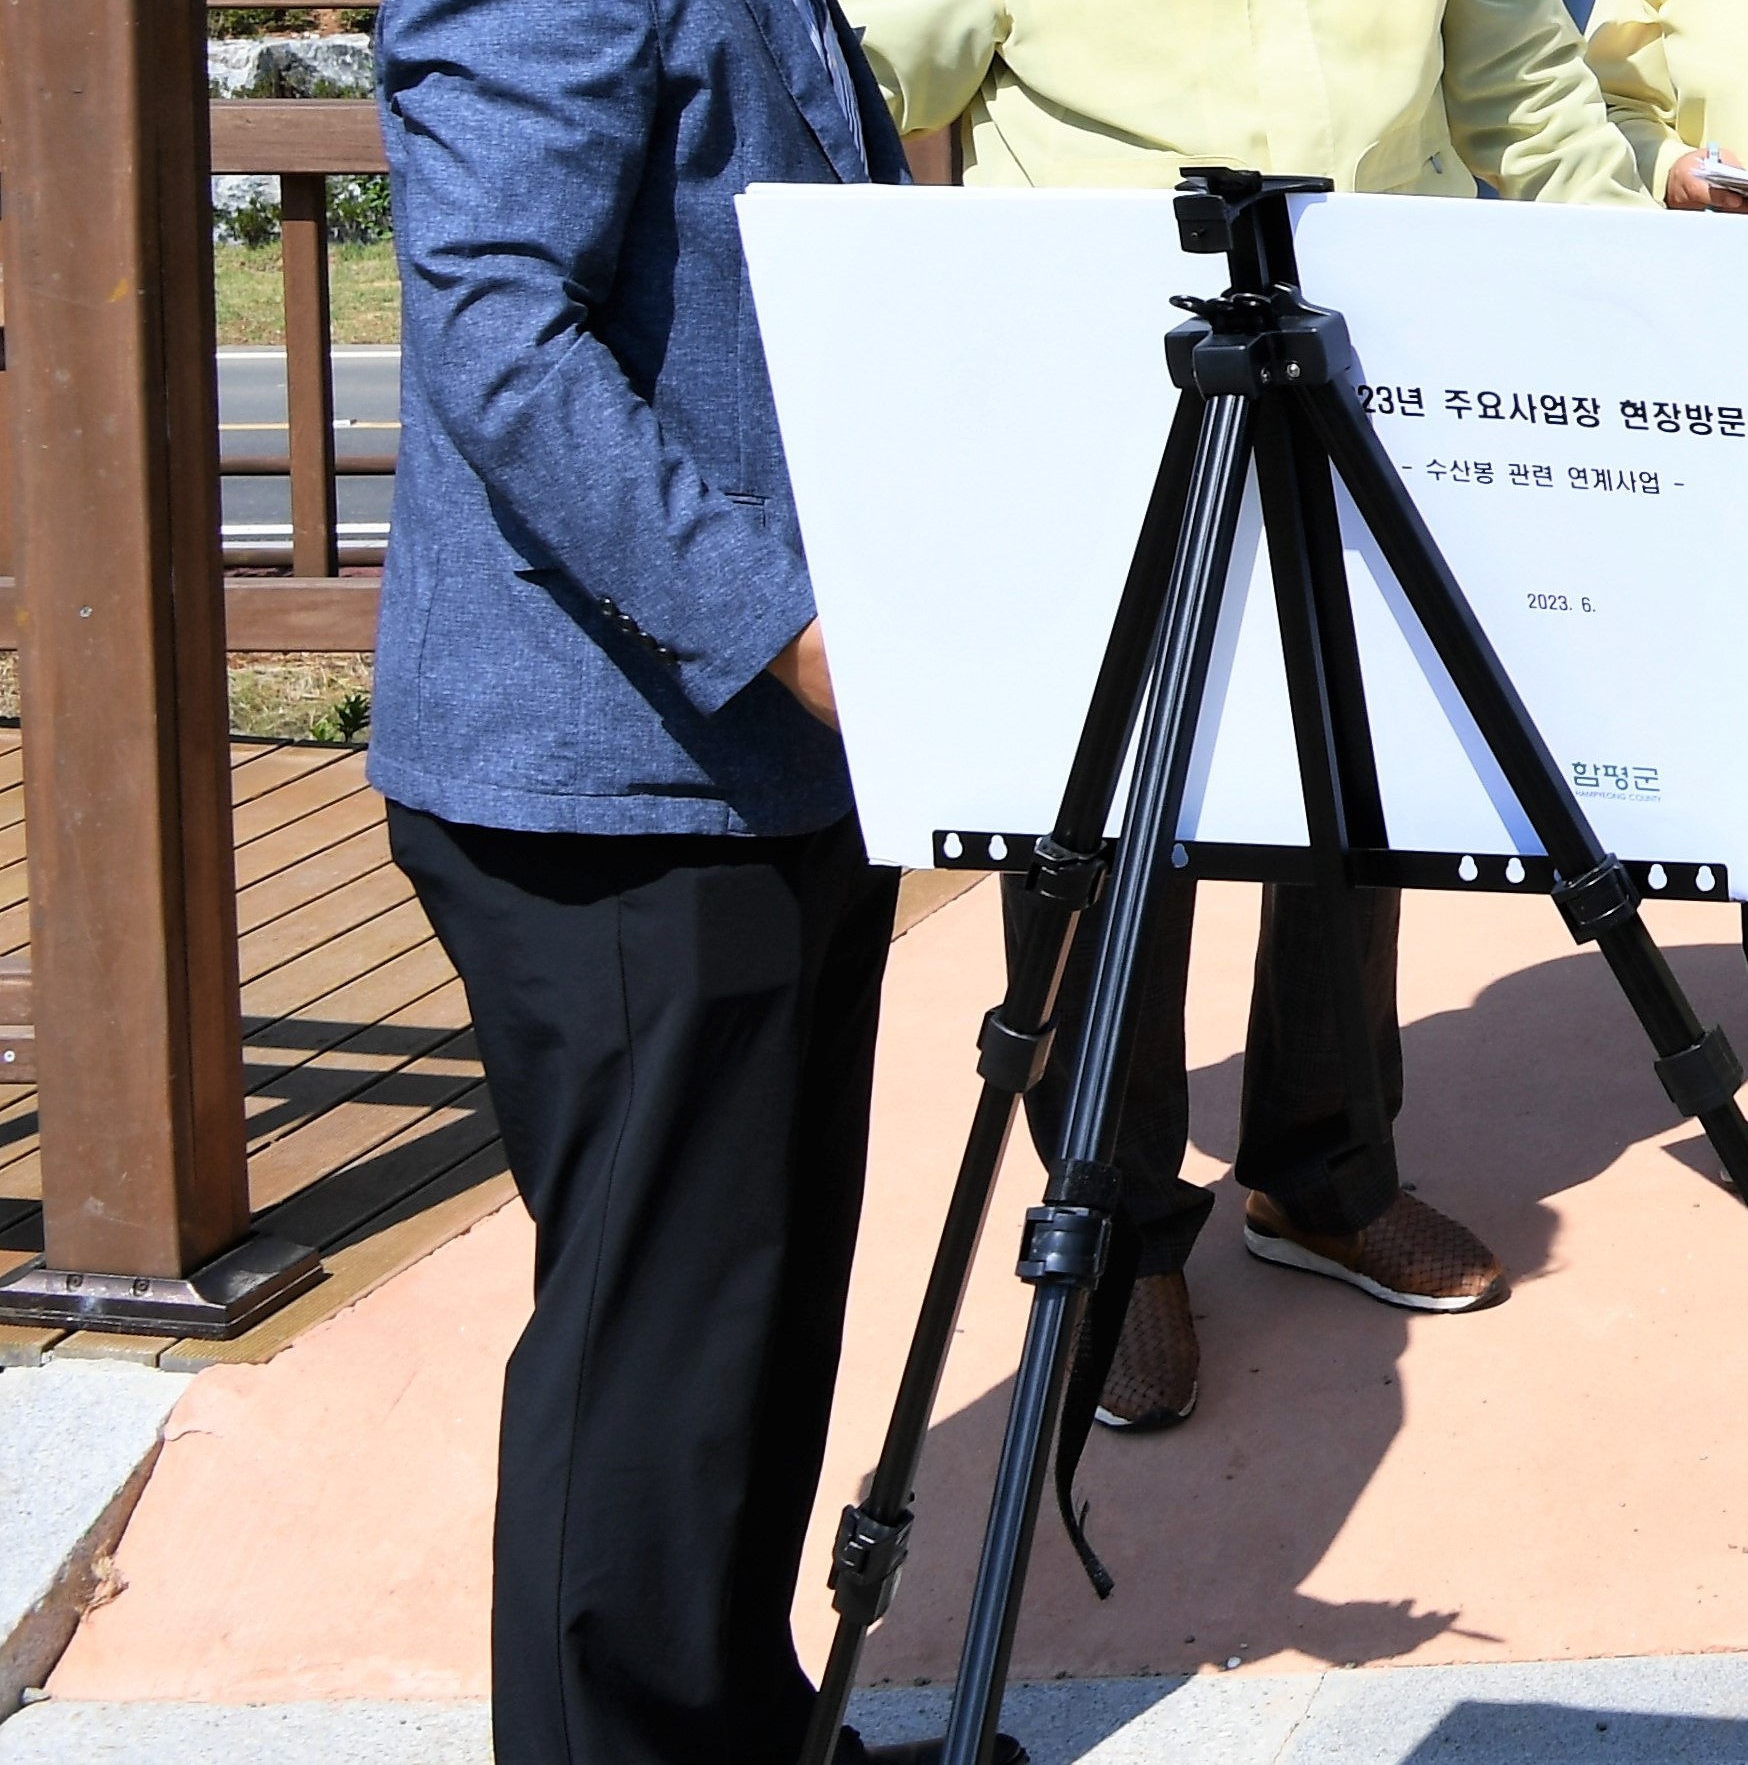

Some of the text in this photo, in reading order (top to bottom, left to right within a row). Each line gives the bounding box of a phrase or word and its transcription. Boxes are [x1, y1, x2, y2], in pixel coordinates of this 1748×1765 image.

[1352, 384, 1747, 438] 23년 주요사업장 현장방문
[1425, 458, 1495, 486] 수산봉
[1508, 462, 1554, 488] 관련
[1567, 465, 1661, 495] 연계사업
[1527, 593, 1597, 613] 2023. 6.
[1571, 761, 1661, 792] 함평군
